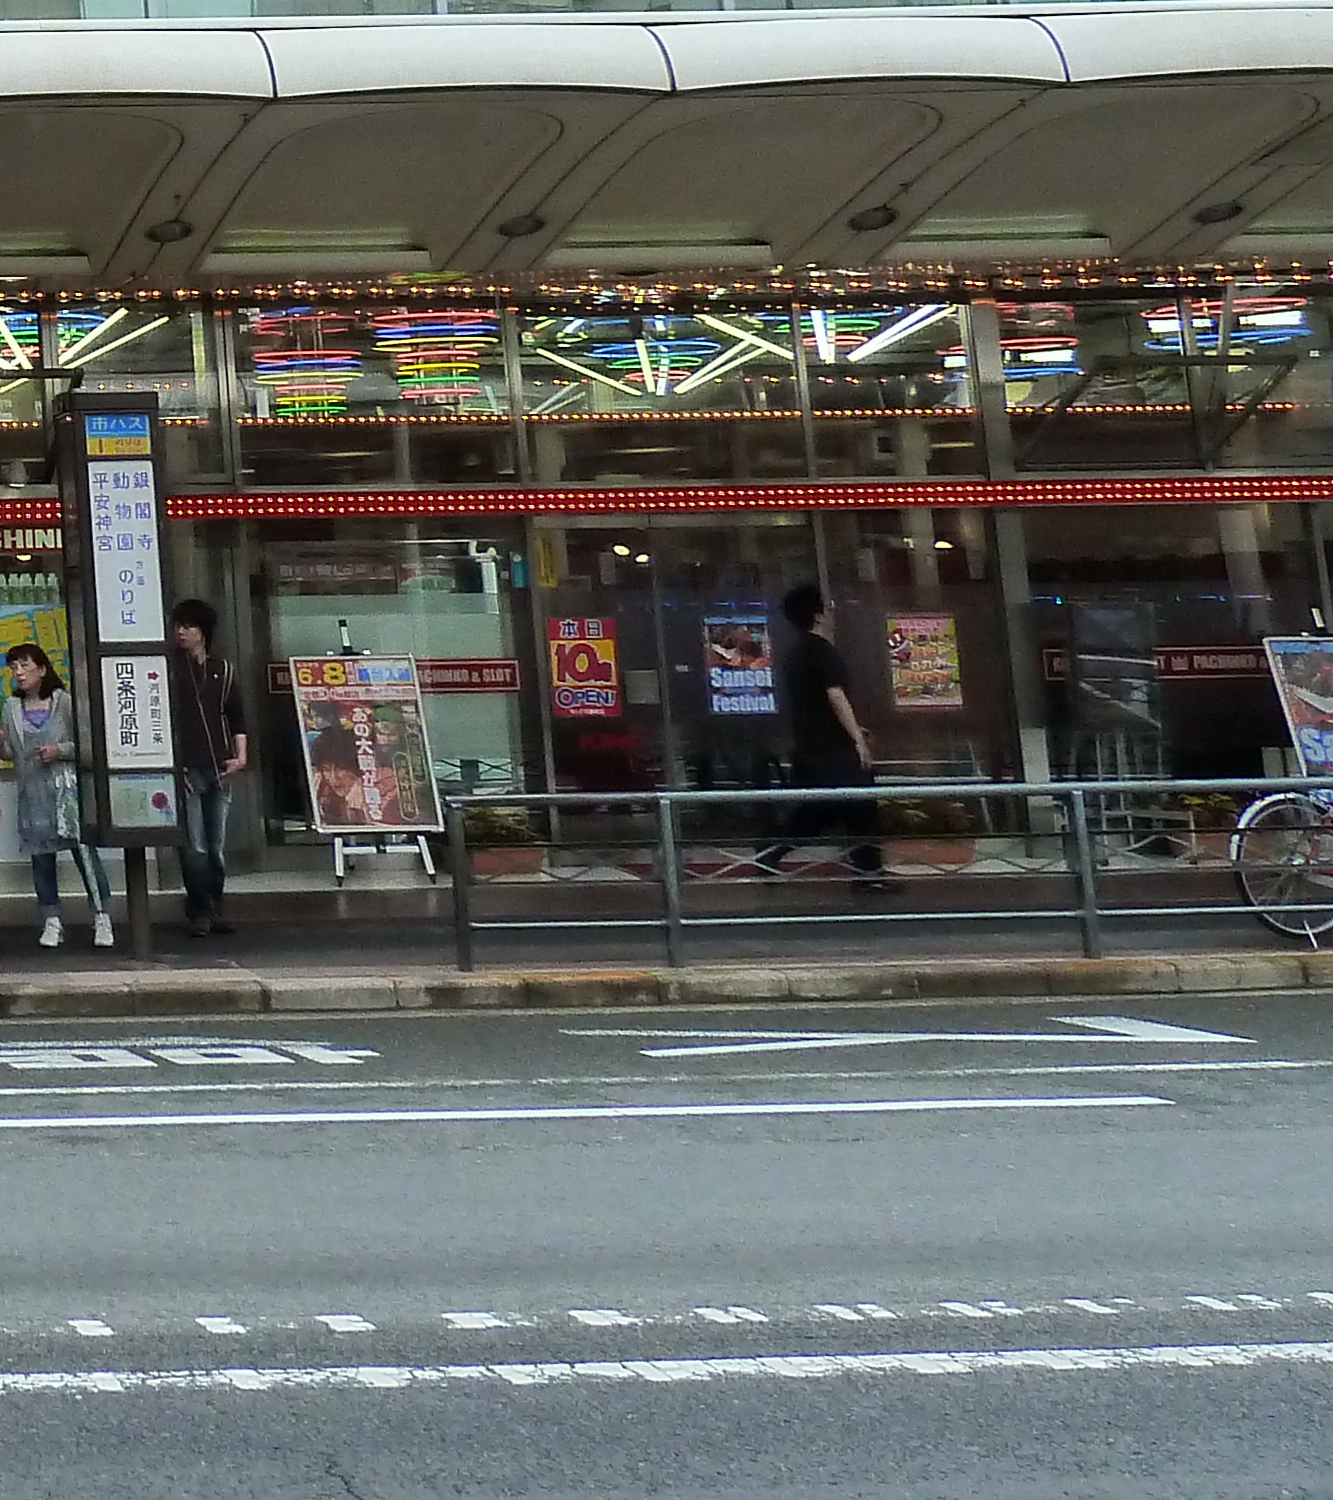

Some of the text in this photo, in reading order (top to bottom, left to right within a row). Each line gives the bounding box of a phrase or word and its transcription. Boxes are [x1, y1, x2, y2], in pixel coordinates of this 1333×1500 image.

[92, 472, 113, 551] 平安神宮
[112, 472, 134, 551] 動物園
[133, 471, 153, 550] 銀閣寺
[119, 568, 136, 625] のりば
[561, 620, 602, 638] 本日
[482, 668, 512, 682] SLOT
[710, 667, 772, 688] Sansei
[116, 662, 140, 747] 四条河原町
[556, 687, 616, 708] OPEN!
[713, 693, 776, 712] Festival
